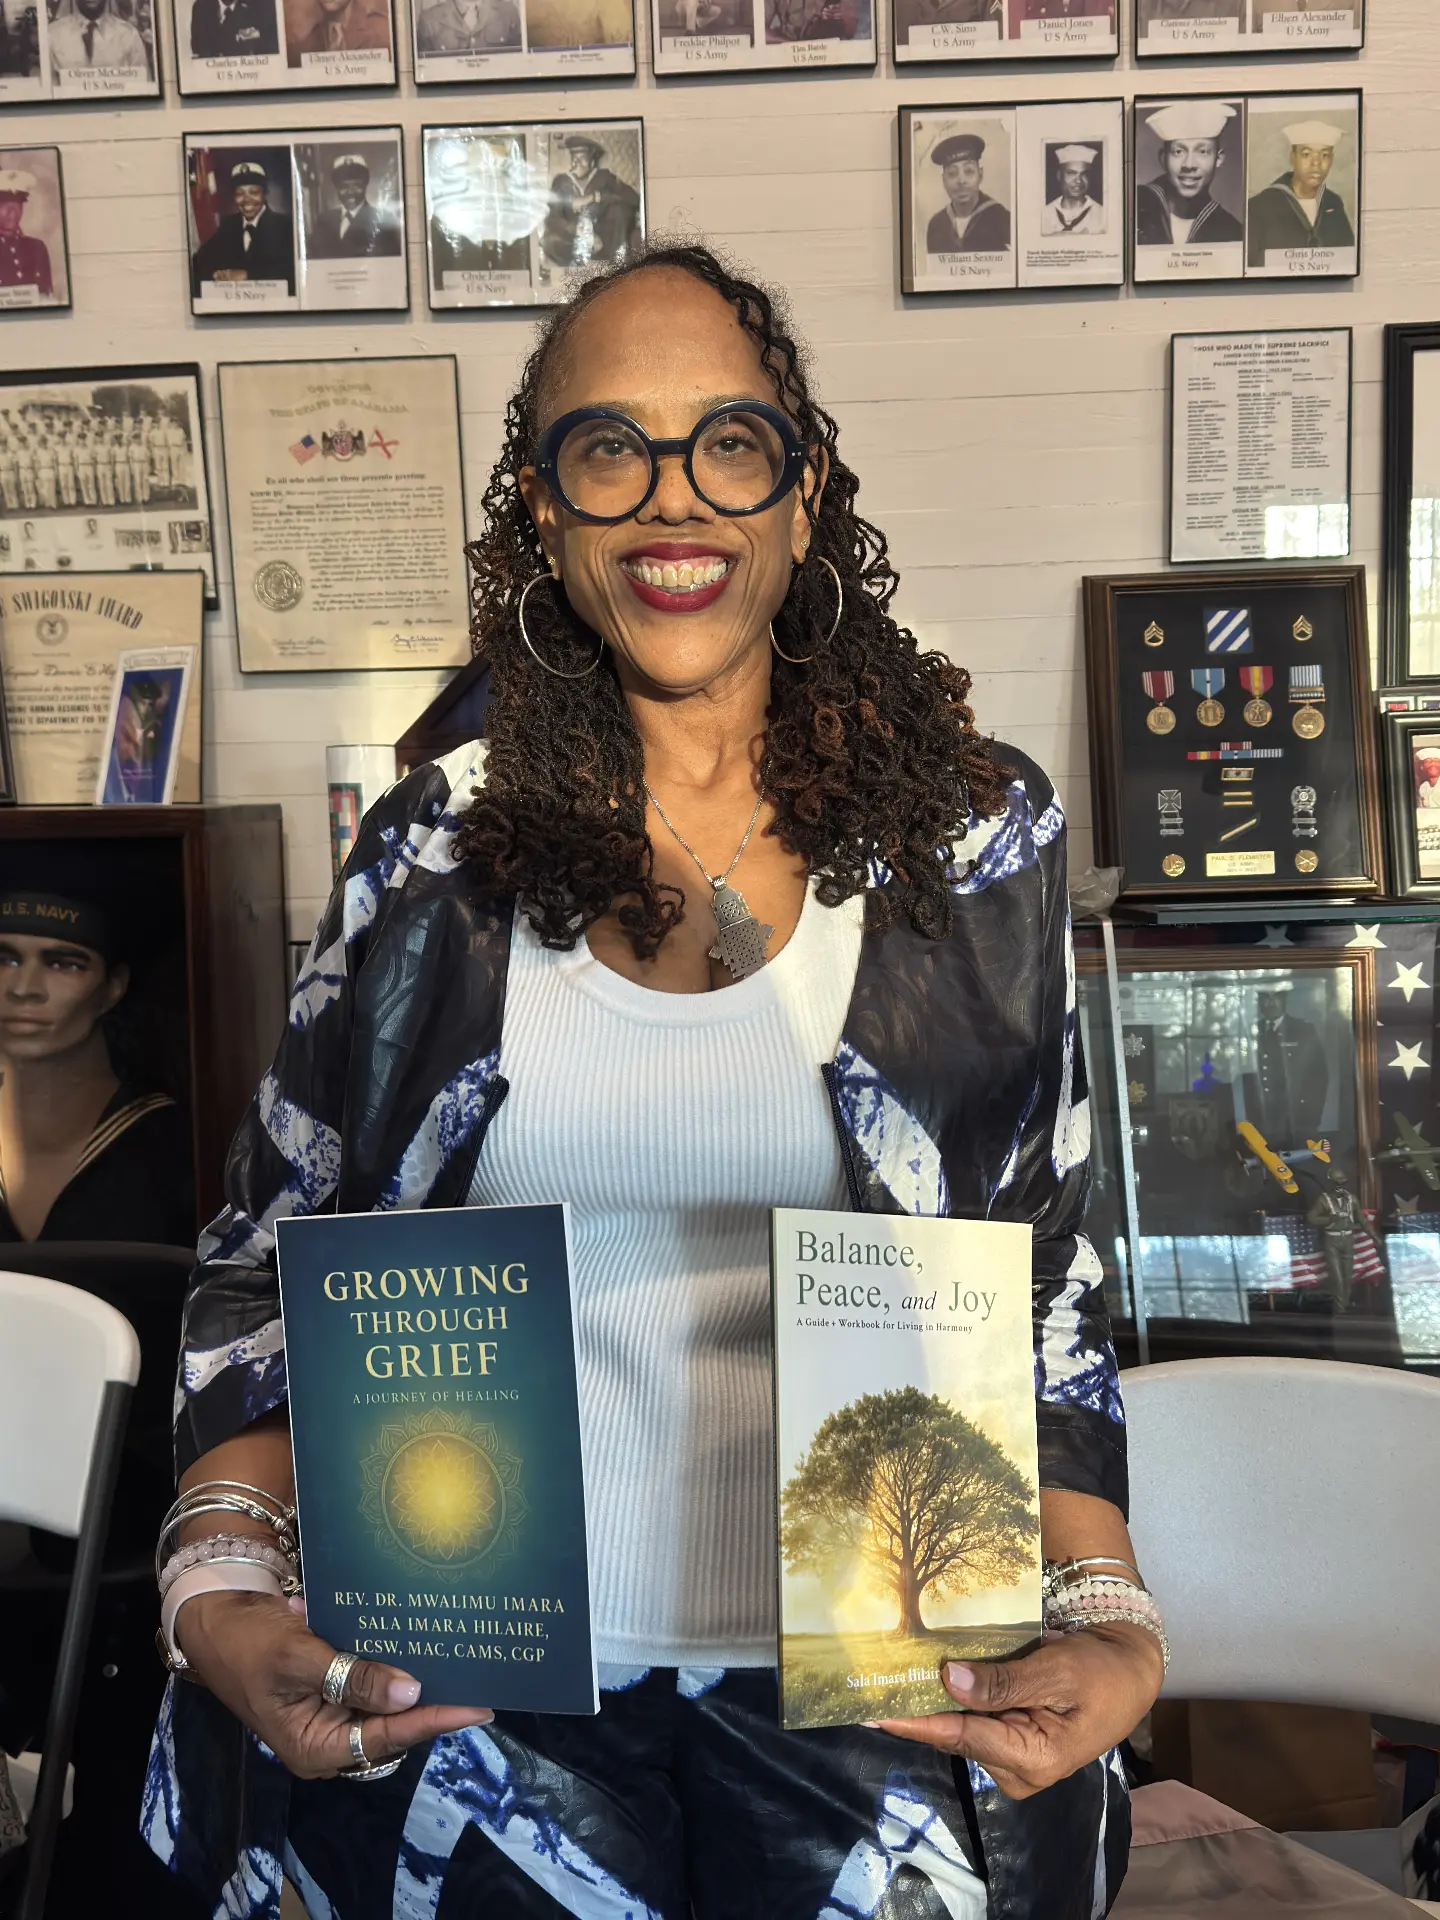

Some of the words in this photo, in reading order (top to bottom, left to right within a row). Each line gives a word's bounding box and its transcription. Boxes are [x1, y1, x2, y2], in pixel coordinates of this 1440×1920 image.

[1038, 19, 1067, 29] Daniel
[1069, 18, 1094, 29] Jones
[1192, 18, 1227, 26] Alexander
[1271, 13, 1298, 24] Elbert
[1301, 12, 1346, 22] Alexander
[931, 25, 953, 34] C.W.
[956, 24, 976, 34] Sims
[1286, 26, 1295, 36] U
[1297, 26, 1302, 35] S
[1304, 26, 1329, 37] Army
[1044, 33, 1052, 42] U
[1054, 32, 1061, 41] S
[1063, 32, 1088, 42] Army
[1172, 31, 1180, 39] U
[1182, 30, 1188, 39] S
[1191, 30, 1216, 40] Army
[673, 38, 706, 48] Freddie
[708, 37, 740, 48] Philpot
[932, 38, 940, 47] U
[943, 38, 949, 46] S
[952, 38, 976, 48] Army
[340, 52, 382, 62] Alexander
[686, 51, 693, 60] U
[695, 51, 702, 60] S
[704, 50, 728, 61] Army
[808, 53, 827, 62] Army
[206, 57, 238, 68] Charles
[241, 55, 268, 66] Rachel
[236, 70, 258, 81] Army
[344, 66, 367, 76] Army
[104, 80, 124, 92] Army
[938, 253, 971, 263] William
[974, 253, 1003, 262] Sexton
[1284, 248, 1308, 258] Chris
[1311, 248, 1334, 258] Jones
[1182, 260, 1198, 268] Navy
[1288, 262, 1296, 271] U
[1298, 262, 1304, 270] S
[1307, 262, 1330, 272] Navy
[950, 267, 958, 276] U
[960, 266, 966, 275] S
[969, 266, 991, 276] Navy
[485, 283, 507, 296] Navy
[244, 290, 266, 302] Navy
[97, 595, 144, 630] AWARD
[36, 716, 79, 724] DEPARTMENT
[36, 903, 80, 924] NAVY
[796, 1230, 923, 1275] Balance,
[323, 1262, 529, 1302] GROWING
[796, 1273, 890, 1315] Peace,
[901, 1290, 937, 1310] and
[948, 1281, 998, 1322] Joy
[350, 1306, 508, 1335] THROUGH
[796, 1318, 803, 1326] A
[805, 1318, 830, 1327] Guide
[838, 1318, 880, 1329] Workbook
[882, 1320, 895, 1330] for
[897, 1320, 924, 1332] Living
[925, 1323, 934, 1331] in
[936, 1322, 973, 1334] Harmony
[365, 1341, 498, 1379] GRIEF
[352, 1394, 361, 1404] A
[366, 1392, 427, 1405] JOURNEY
[432, 1391, 449, 1401] OF
[456, 1389, 520, 1402] HEALING
[334, 1592, 369, 1606] REV.
[375, 1592, 402, 1607] DR.
[408, 1593, 496, 1610] MWALIMU
[504, 1596, 565, 1613] IMARA
[358, 1615, 401, 1630] SALA
[408, 1616, 467, 1633] IMARA
[474, 1619, 550, 1640] HILAIRE,
[355, 1639, 402, 1657] LCSW,
[408, 1641, 450, 1659] MAC,
[454, 1643, 507, 1663] CAMS,
[511, 1646, 545, 1663] CGP
[846, 1674, 870, 1688] Sala
[873, 1672, 906, 1686] Imara
[908, 1667, 940, 1682] Hilair
